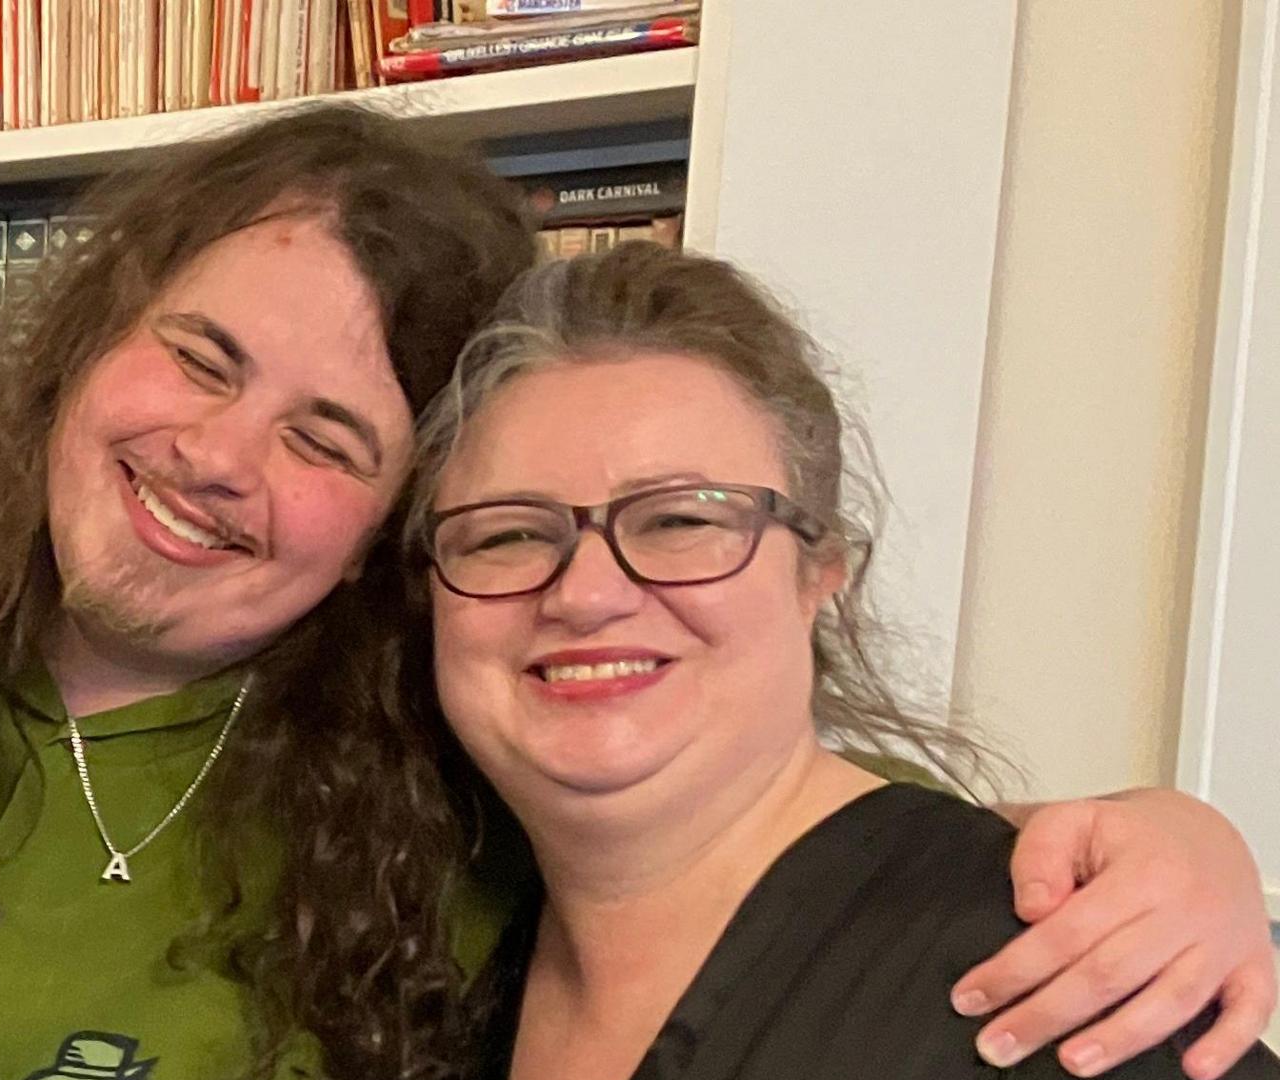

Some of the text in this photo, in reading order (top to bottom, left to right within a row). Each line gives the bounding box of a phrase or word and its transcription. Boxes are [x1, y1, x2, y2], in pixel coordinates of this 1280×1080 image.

[559, 182, 660, 203] DARK CARNIVAL
[101, 853, 131, 881] A
